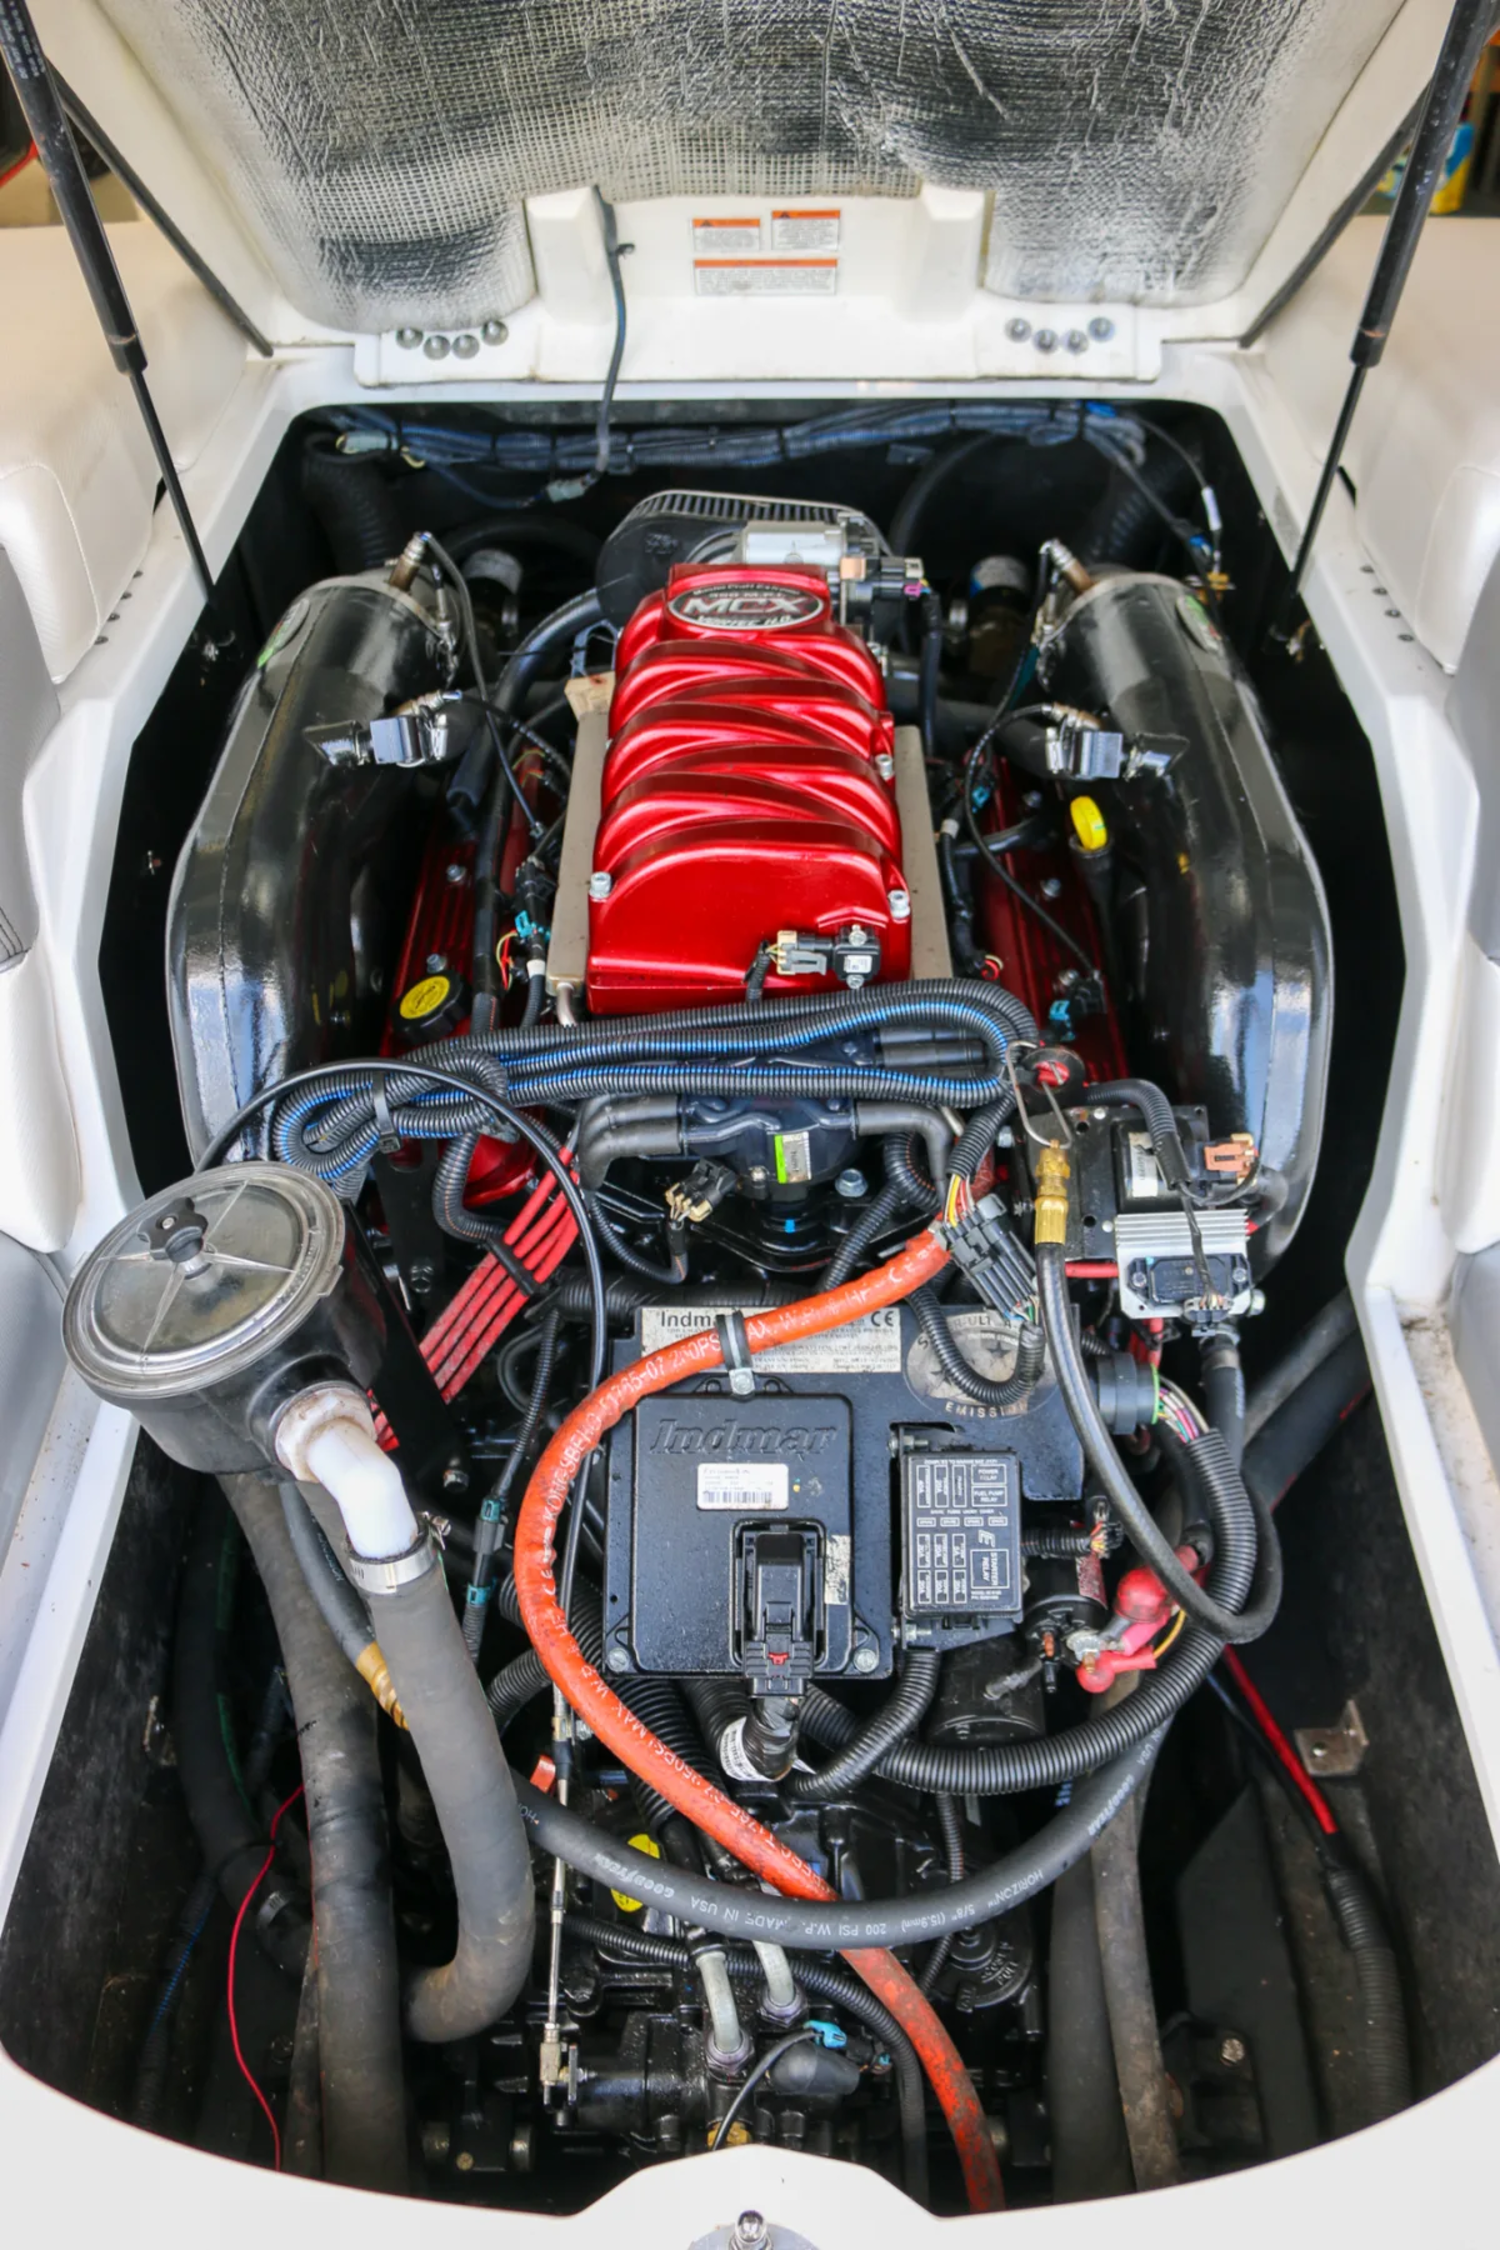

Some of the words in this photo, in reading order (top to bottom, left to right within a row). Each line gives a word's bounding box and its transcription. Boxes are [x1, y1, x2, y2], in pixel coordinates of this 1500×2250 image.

[683, 598, 809, 614] MCX
[661, 1311, 716, 1327] Indm
[871, 1311, 894, 1327] CE
[650, 1418, 838, 1454] Indmar
[982, 1556, 991, 1582] RELAY
[990, 1551, 999, 1587] STARTER
[594, 1853, 675, 1898] GOODYEAR
[691, 1896, 717, 1915] USA
[724, 1908, 739, 1921] IN
[745, 1914, 787, 1929] MADE
[903, 1911, 946, 1931] (15.9mm)
[801, 1922, 830, 1935] W.P.
[838, 1924, 858, 1935] PSI
[865, 1922, 886, 1934] 200
